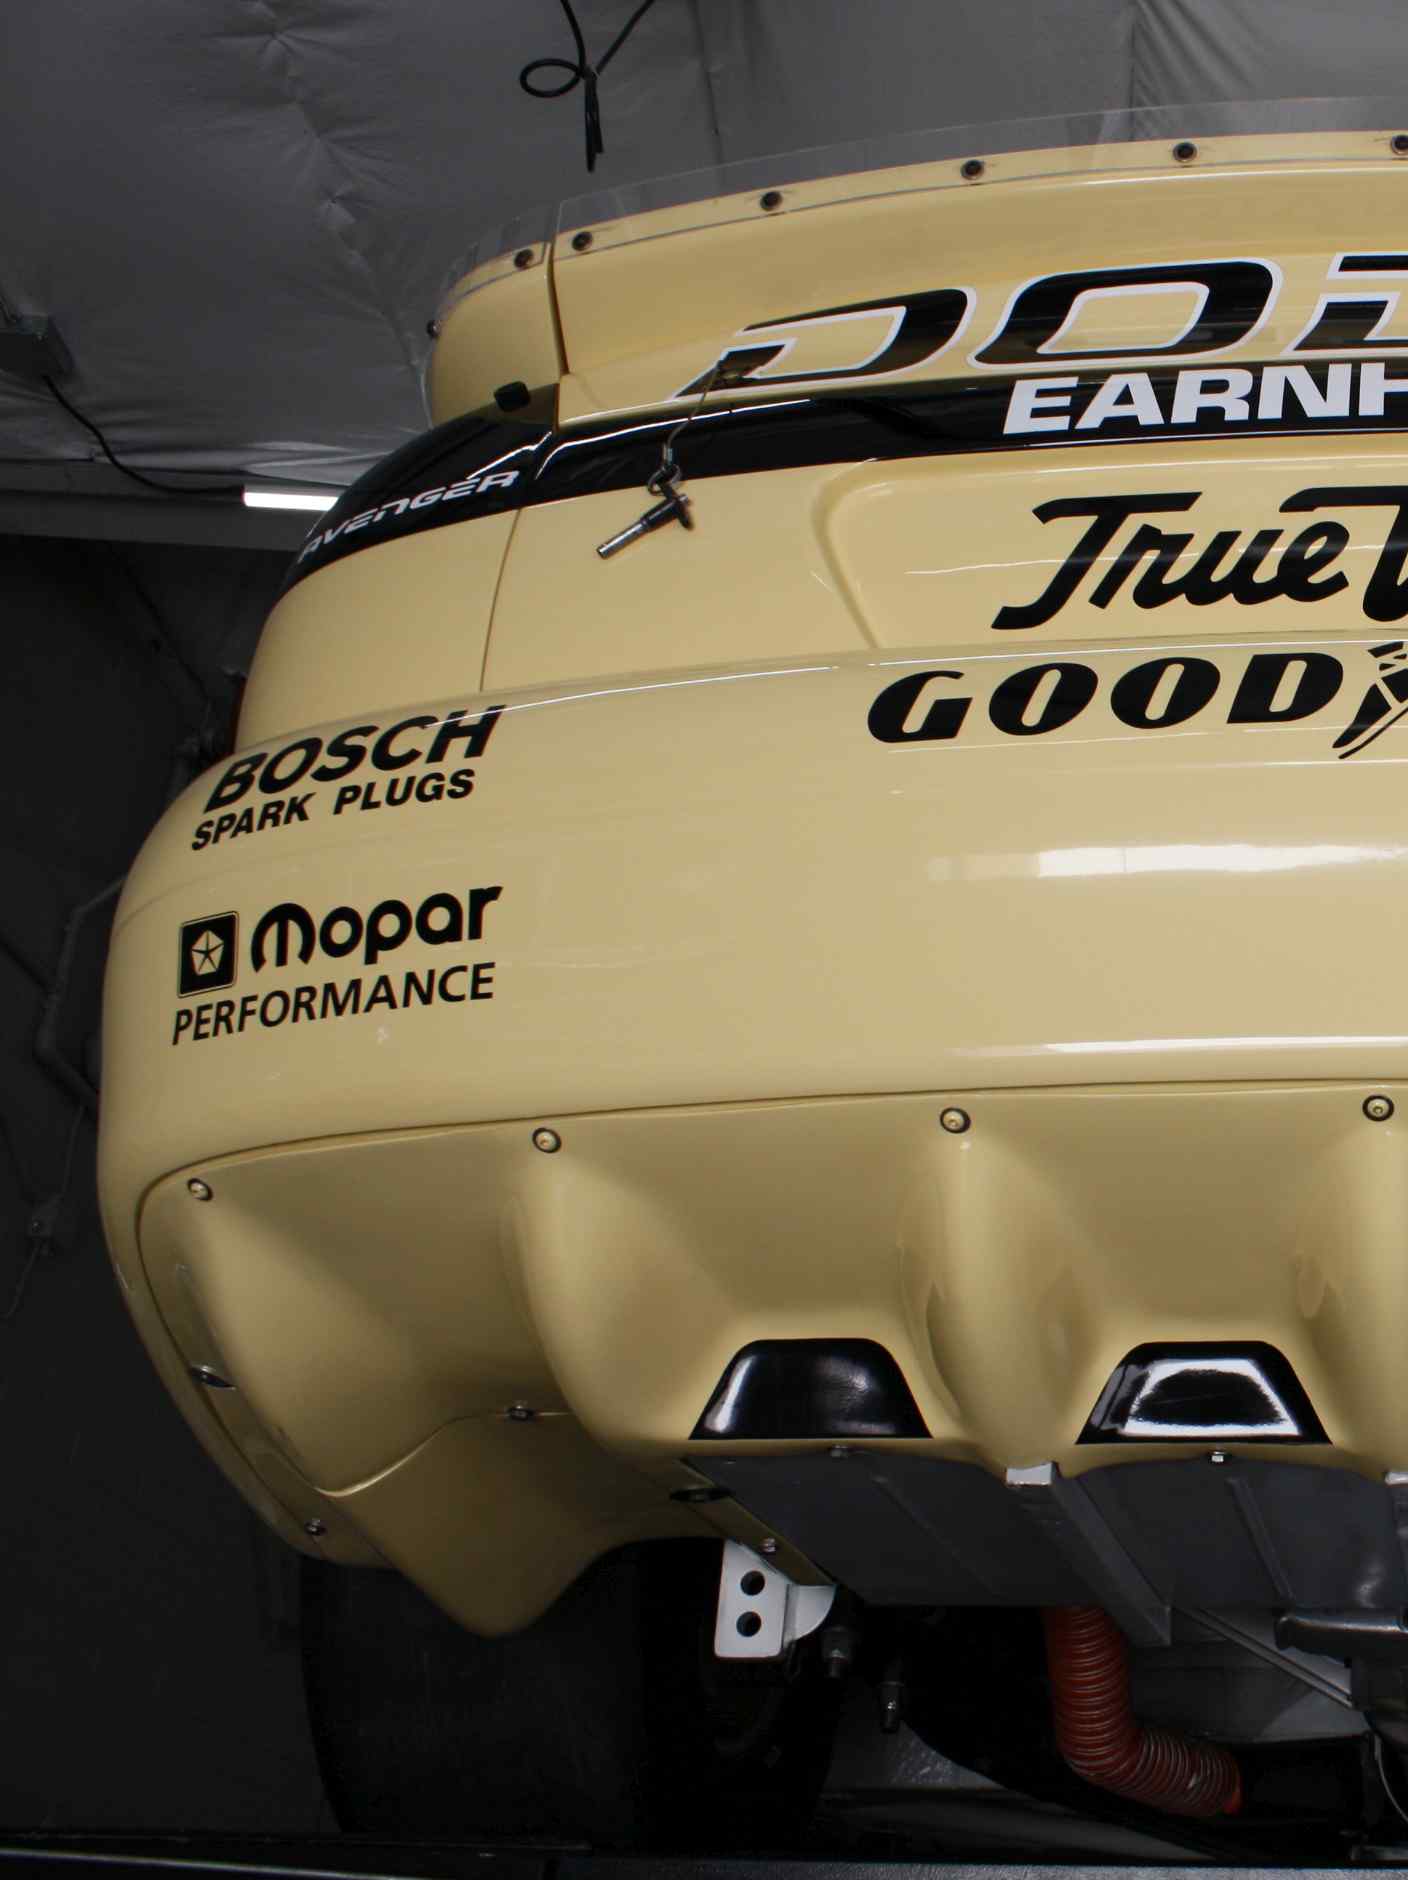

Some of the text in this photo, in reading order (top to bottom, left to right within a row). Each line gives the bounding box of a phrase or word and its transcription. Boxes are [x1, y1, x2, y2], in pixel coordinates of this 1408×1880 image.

[990, 490, 1350, 631] True
[203, 704, 507, 814] BOSCH
[191, 768, 476, 851] SPARK PLUGS
[250, 885, 504, 973] Mopar
[171, 961, 497, 1046] PERFORMANCE
